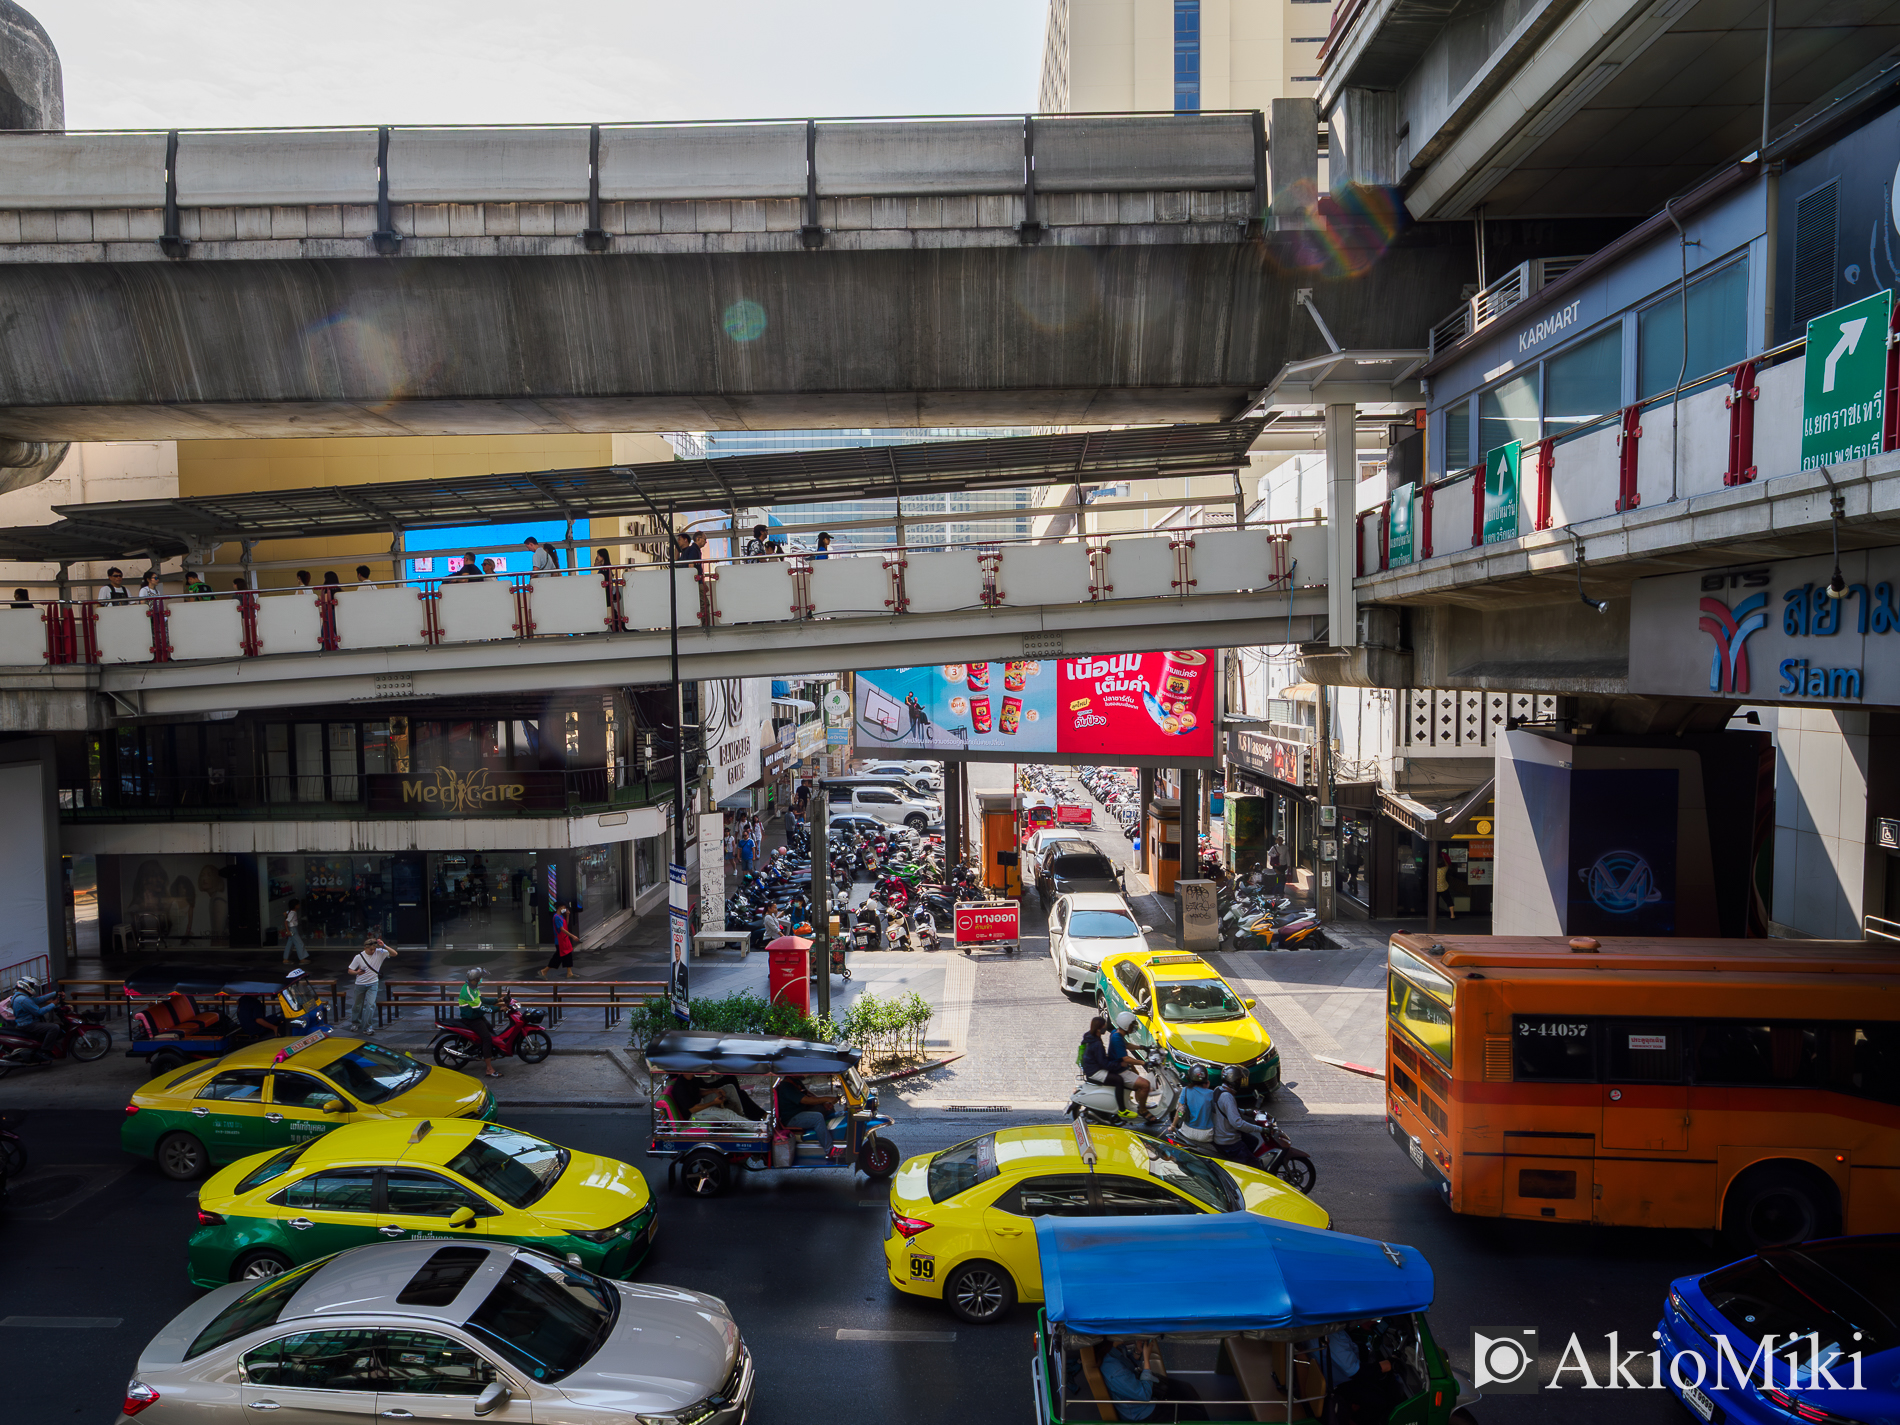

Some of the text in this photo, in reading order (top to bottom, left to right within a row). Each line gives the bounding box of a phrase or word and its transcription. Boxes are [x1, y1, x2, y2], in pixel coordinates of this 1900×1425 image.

[1519, 299, 1581, 353] KARMART
[1804, 389, 1882, 437] แยกราชเทวี
[1803, 431, 1880, 470] ถนนเพชรบรี
[1701, 569, 1770, 591] BTS
[1783, 581, 1900, 636] สยาม
[1095, 674, 1150, 695] เต็มคำ
[1779, 658, 1862, 698] Siam
[312, 876, 343, 886] 2026
[975, 913, 1016, 923] ทางออก
[480, 1005, 493, 1013] Grab
[1519, 1023, 1588, 1037] 2-44057
[290, 1120, 326, 1134] แท็กซี่บุคคล
[911, 1259, 934, 1278] 99
